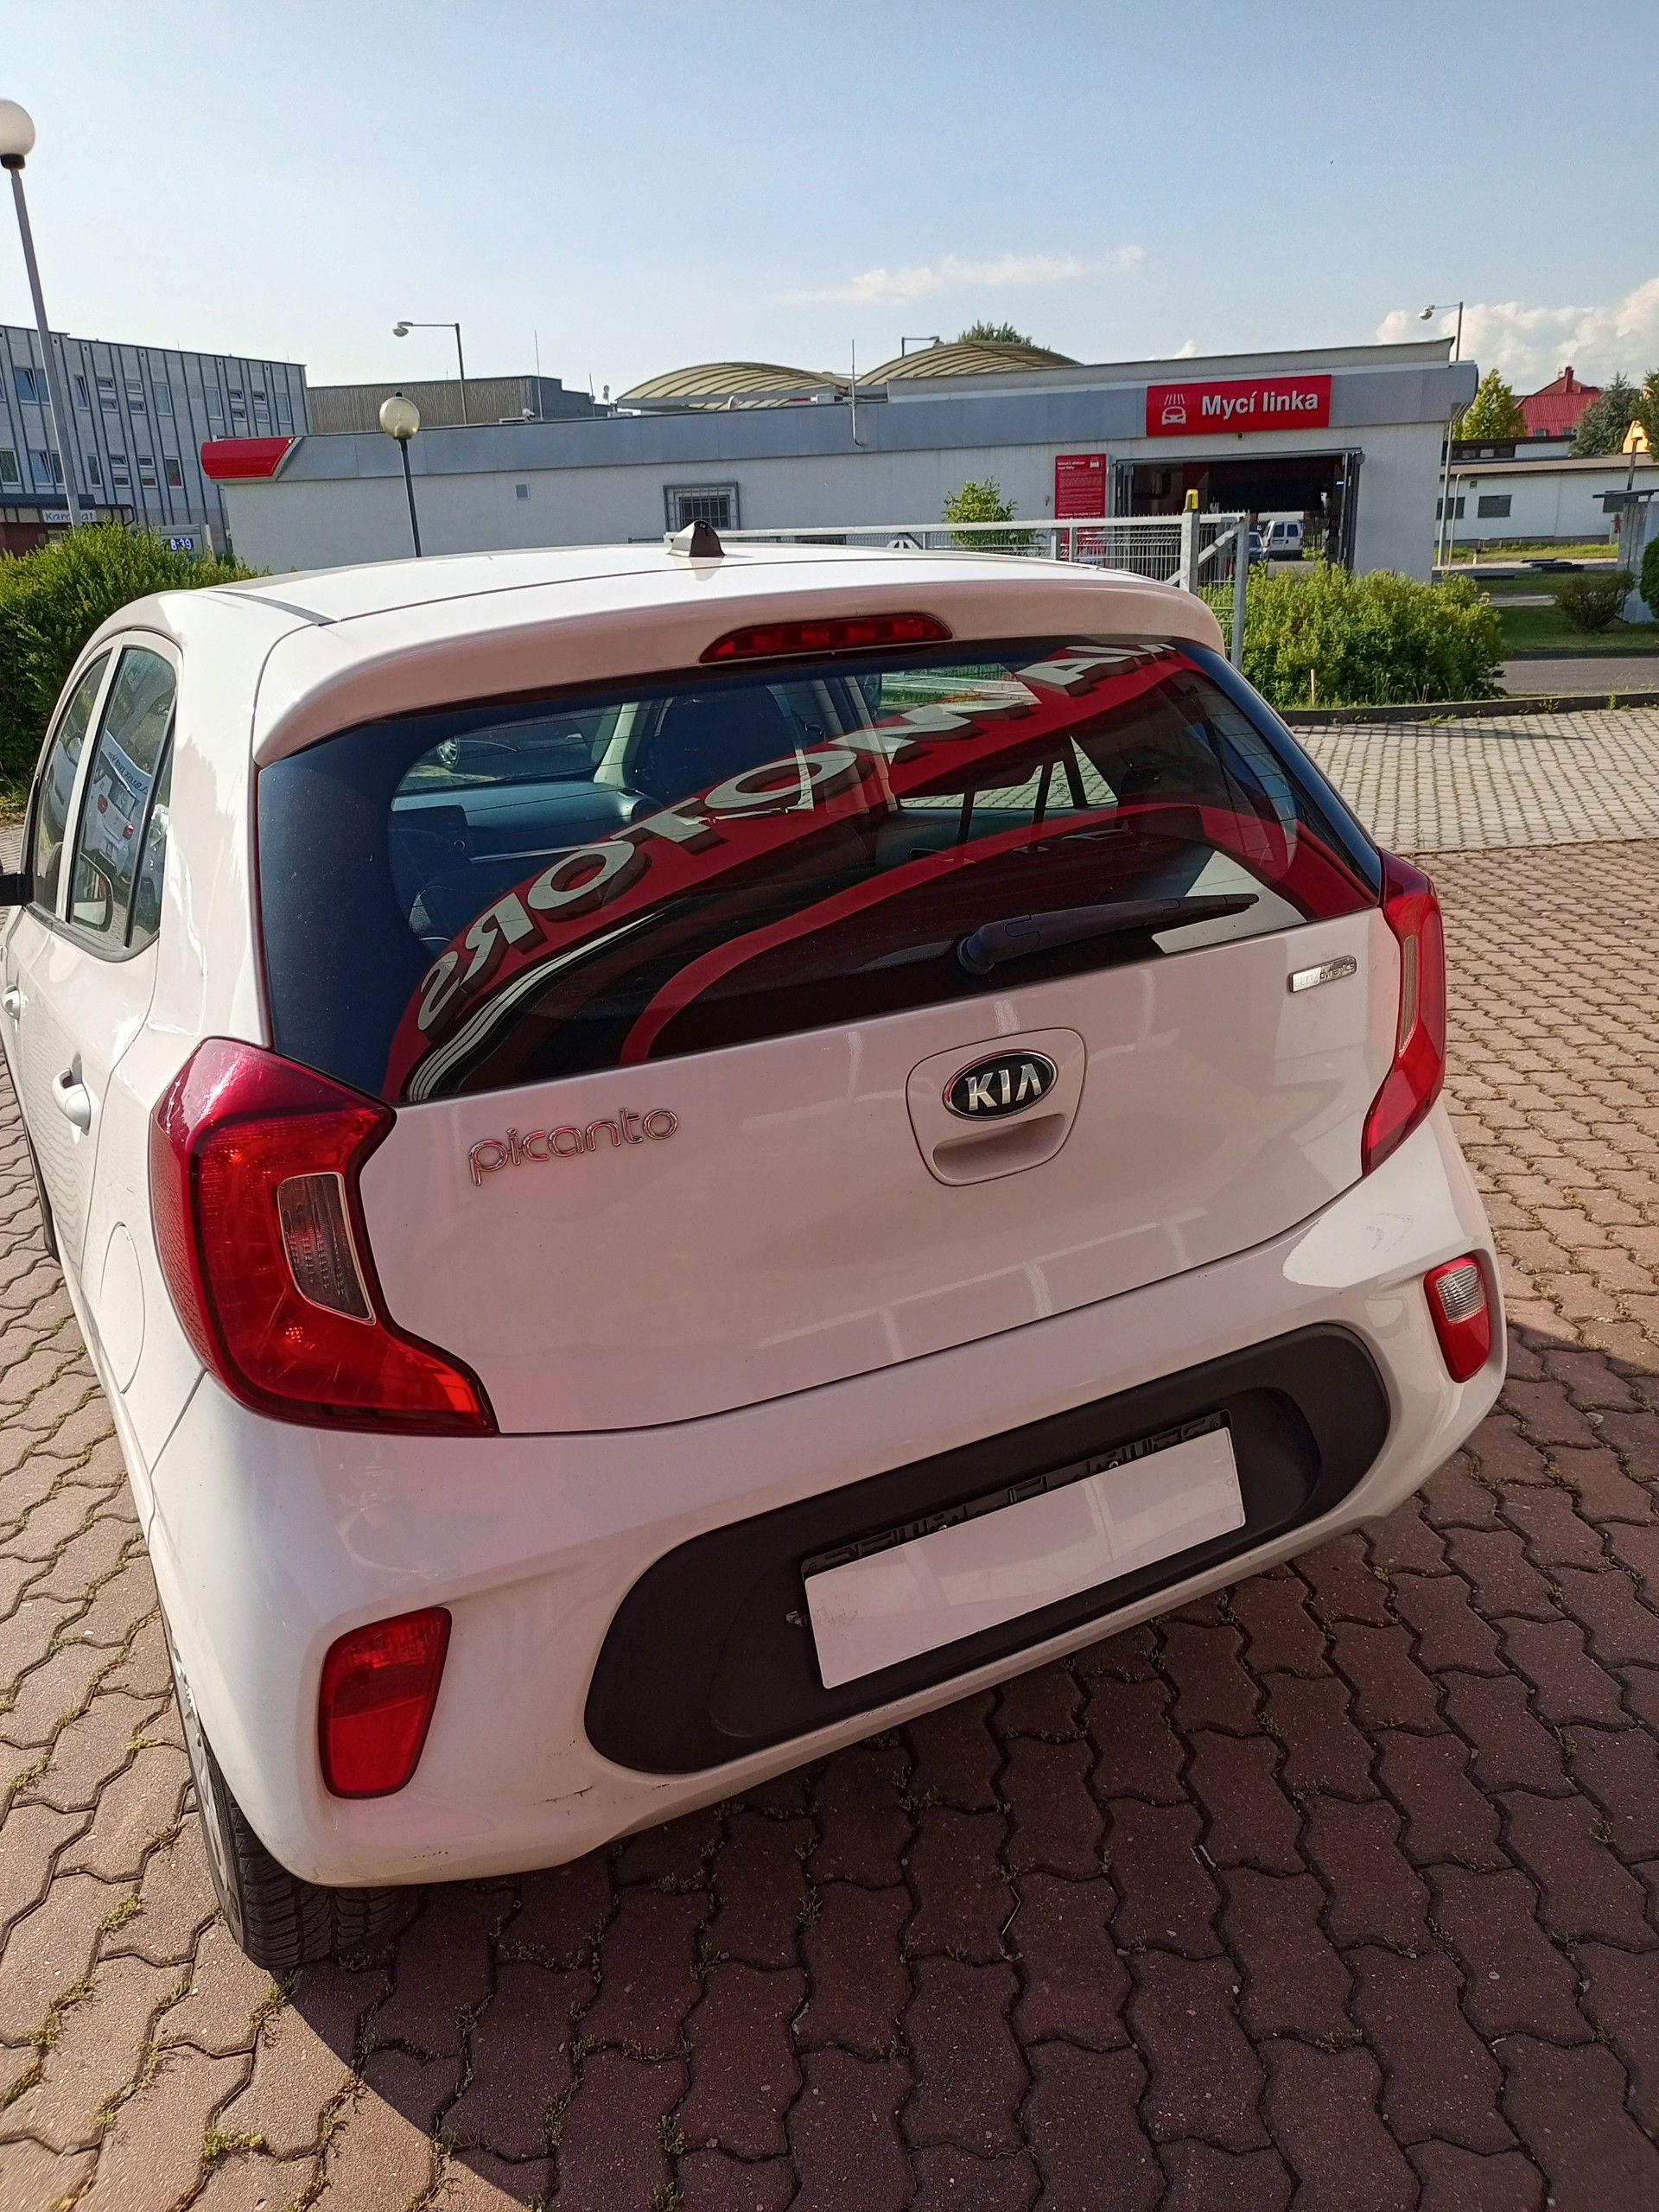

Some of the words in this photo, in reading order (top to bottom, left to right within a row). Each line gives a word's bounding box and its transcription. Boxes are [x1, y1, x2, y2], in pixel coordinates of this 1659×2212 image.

[1201, 391, 1257, 420] Mycí
[1262, 390, 1319, 412] linka
[965, 1063, 1042, 1111] KIA
[468, 1107, 678, 1186] picanto
